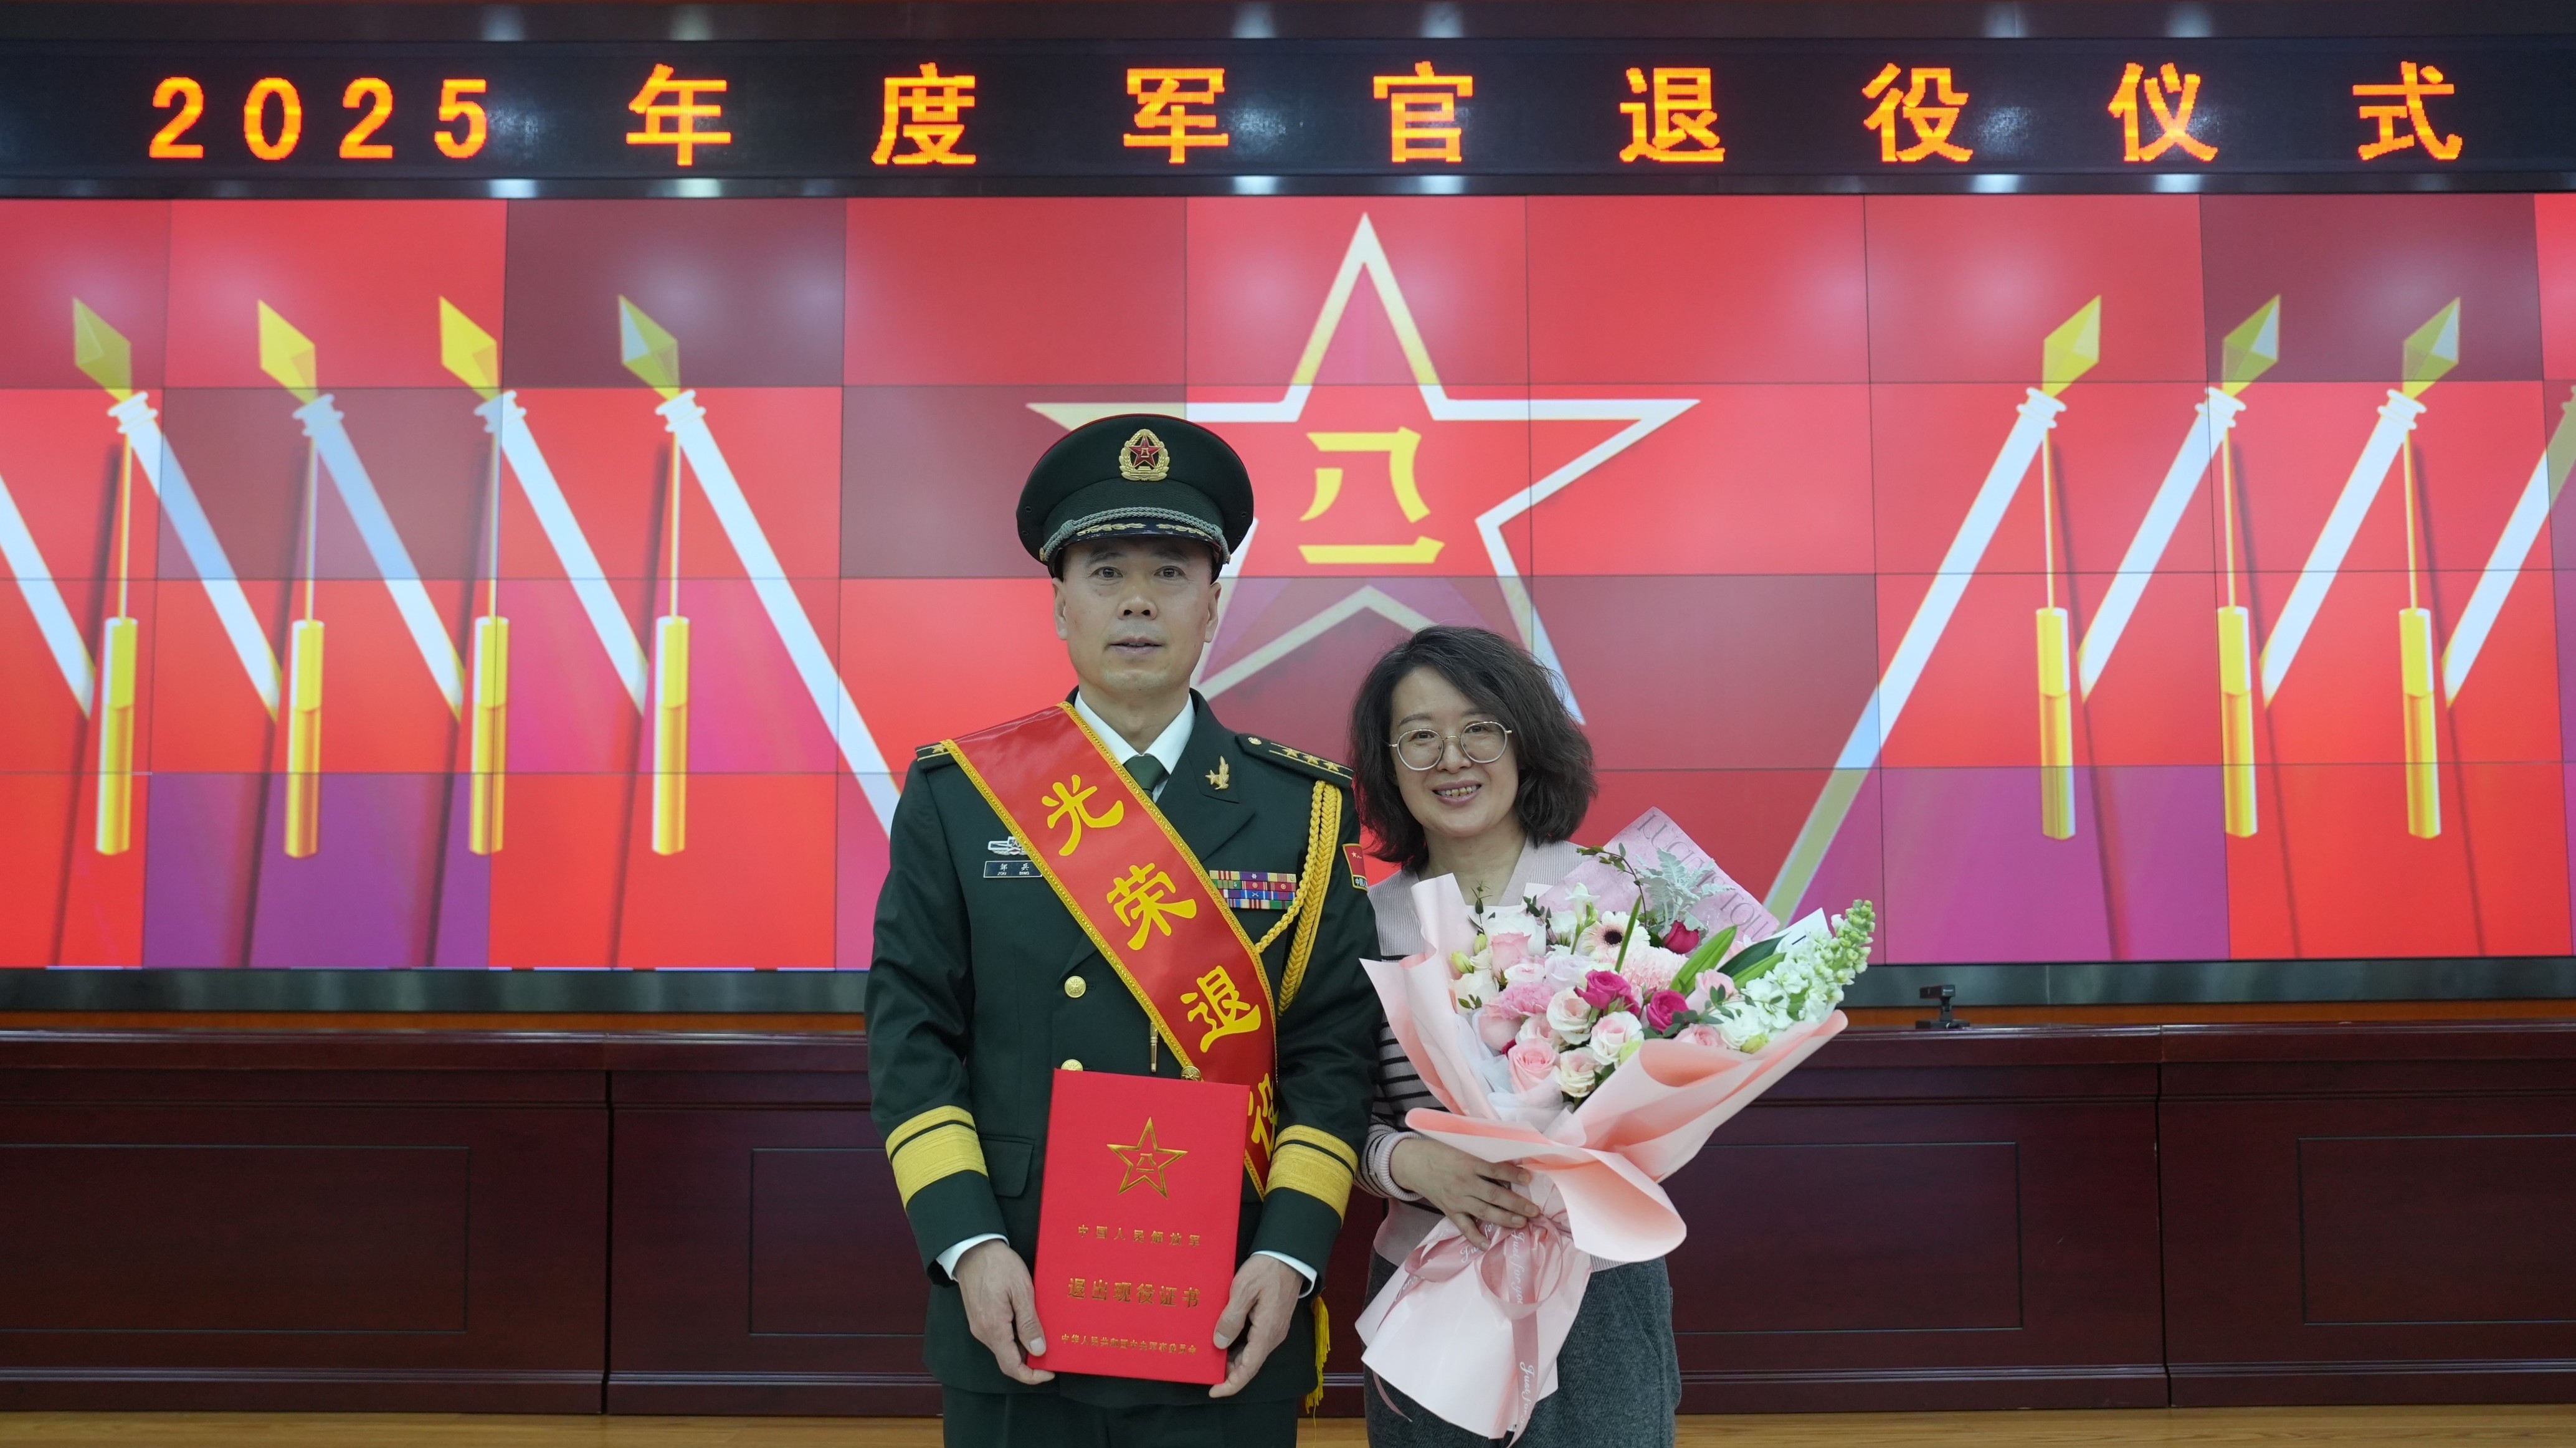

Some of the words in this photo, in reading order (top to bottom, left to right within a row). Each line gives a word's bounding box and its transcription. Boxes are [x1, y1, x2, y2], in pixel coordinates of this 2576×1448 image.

[148, 61, 2463, 167] 2025年度军官退役仪式
[1298, 425, 1445, 564] 八一
[1078, 1224, 1201, 1247] 中国人民解放军
[1511, 1231, 1525, 1258] Just
[1509, 1255, 1525, 1282] for
[1067, 1277, 1200, 1308] 退出现役证书
[1061, 1333, 1197, 1355] 中华人民共和国中央军事委员会
[1519, 1361, 1535, 1394] Just
[1521, 1390, 1531, 1416] for
